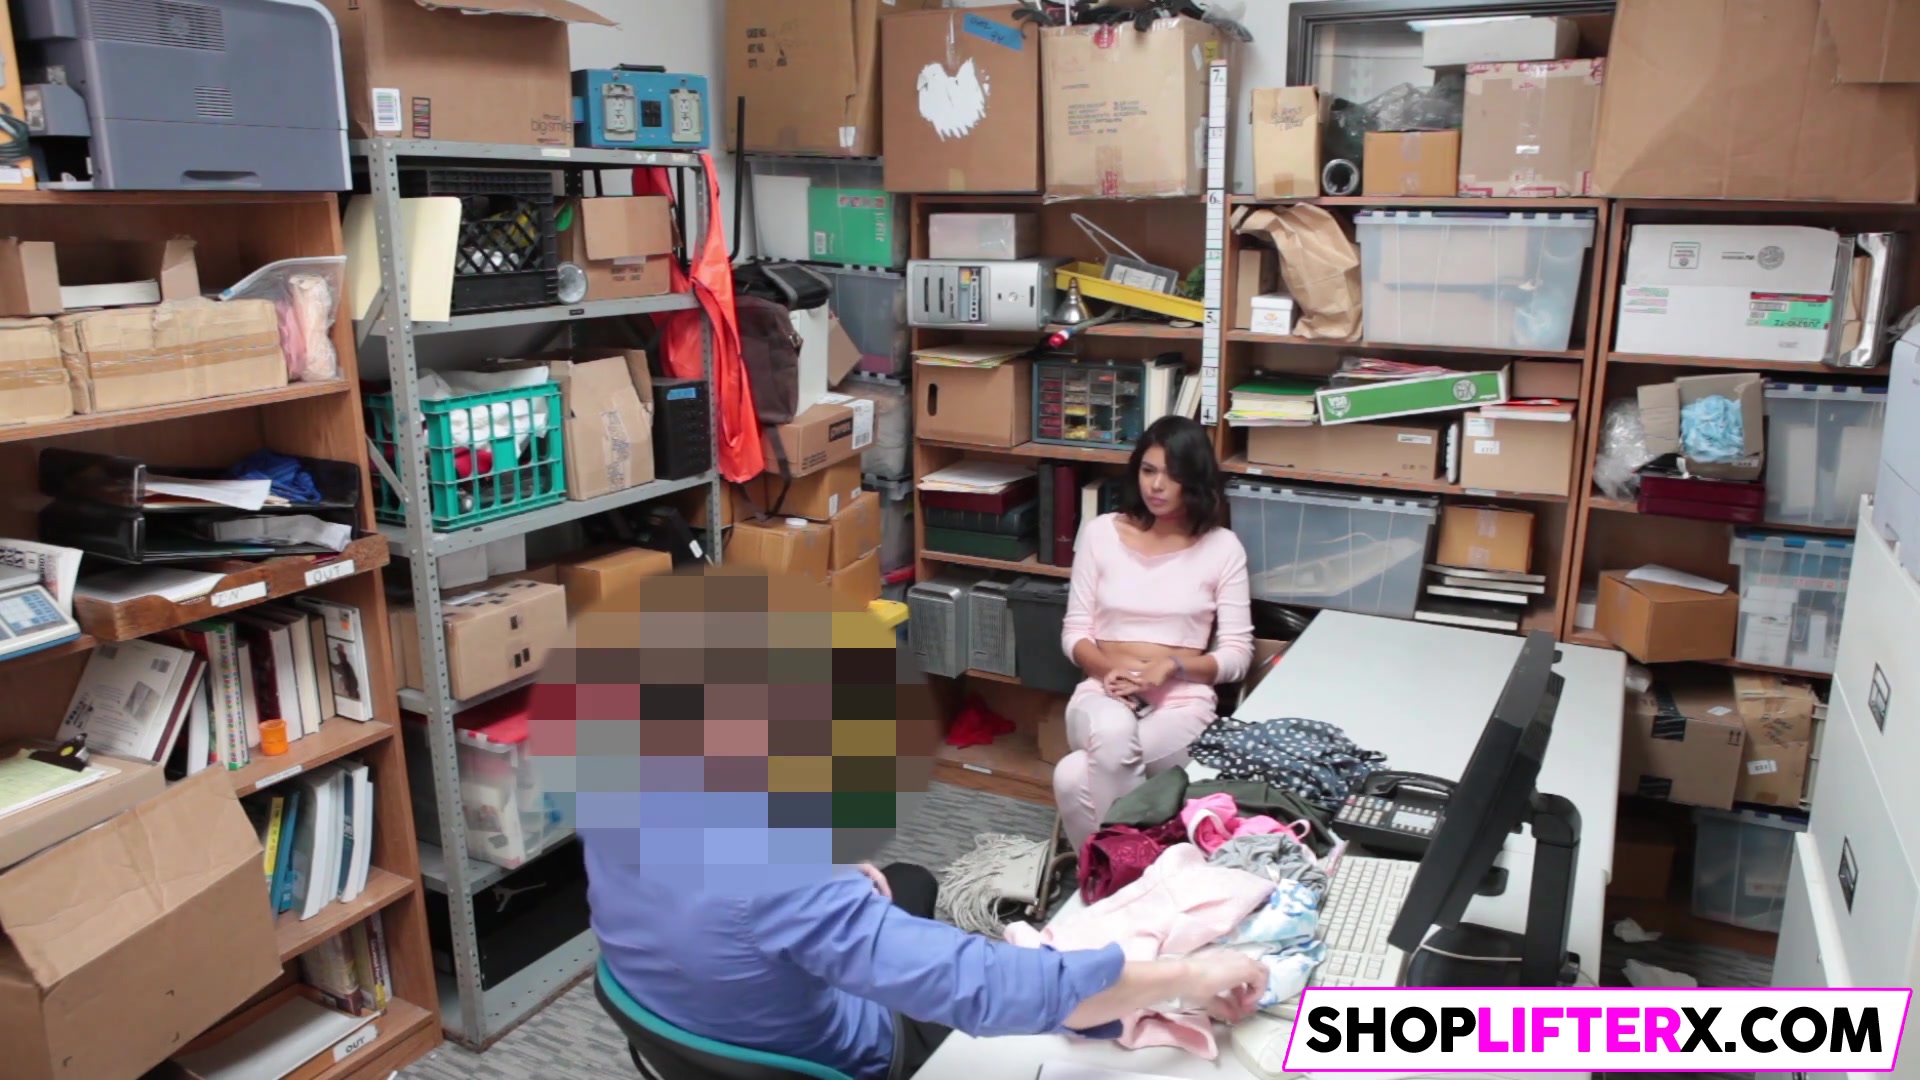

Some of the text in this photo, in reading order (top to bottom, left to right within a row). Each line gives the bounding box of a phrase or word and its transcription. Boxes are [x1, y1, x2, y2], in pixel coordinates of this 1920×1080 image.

[312, 564, 342, 583] OUT
[217, 589, 240, 605] IN
[345, 1035, 366, 1053] OUT
